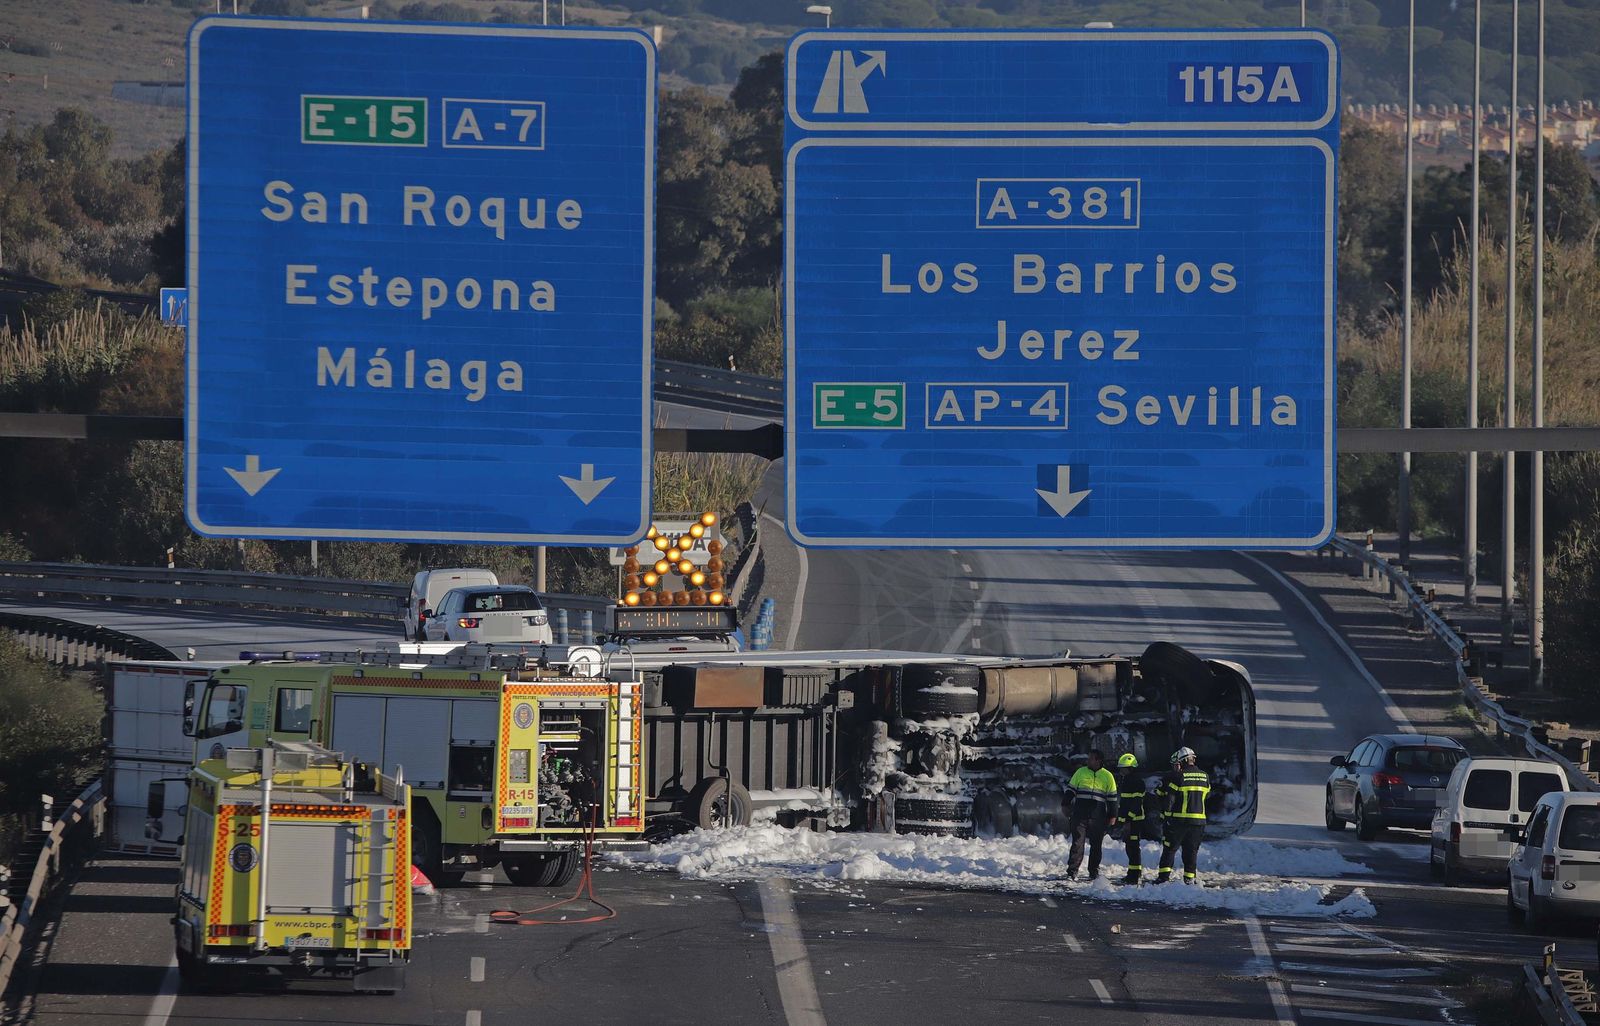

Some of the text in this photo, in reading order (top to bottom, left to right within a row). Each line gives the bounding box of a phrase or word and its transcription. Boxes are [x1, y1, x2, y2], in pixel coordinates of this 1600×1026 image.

[1179, 66, 1301, 103] 1115A
[308, 103, 417, 140] E-15
[453, 108, 538, 142] A-7
[261, 180, 582, 240] San Roque
[986, 187, 1132, 220] A-381
[286, 264, 556, 319] Estepona
[882, 254, 1237, 294] Los Barrios
[976, 320, 1141, 360] Jerez
[317, 347, 524, 402] Málaga
[820, 389, 898, 422] E-5
[933, 389, 1060, 422] AP-4
[1096, 384, 1297, 426] Sevilla
[509, 789, 534, 800] R-15
[218, 823, 260, 837] S-25
[274, 920, 344, 930] www.cbpc.es
